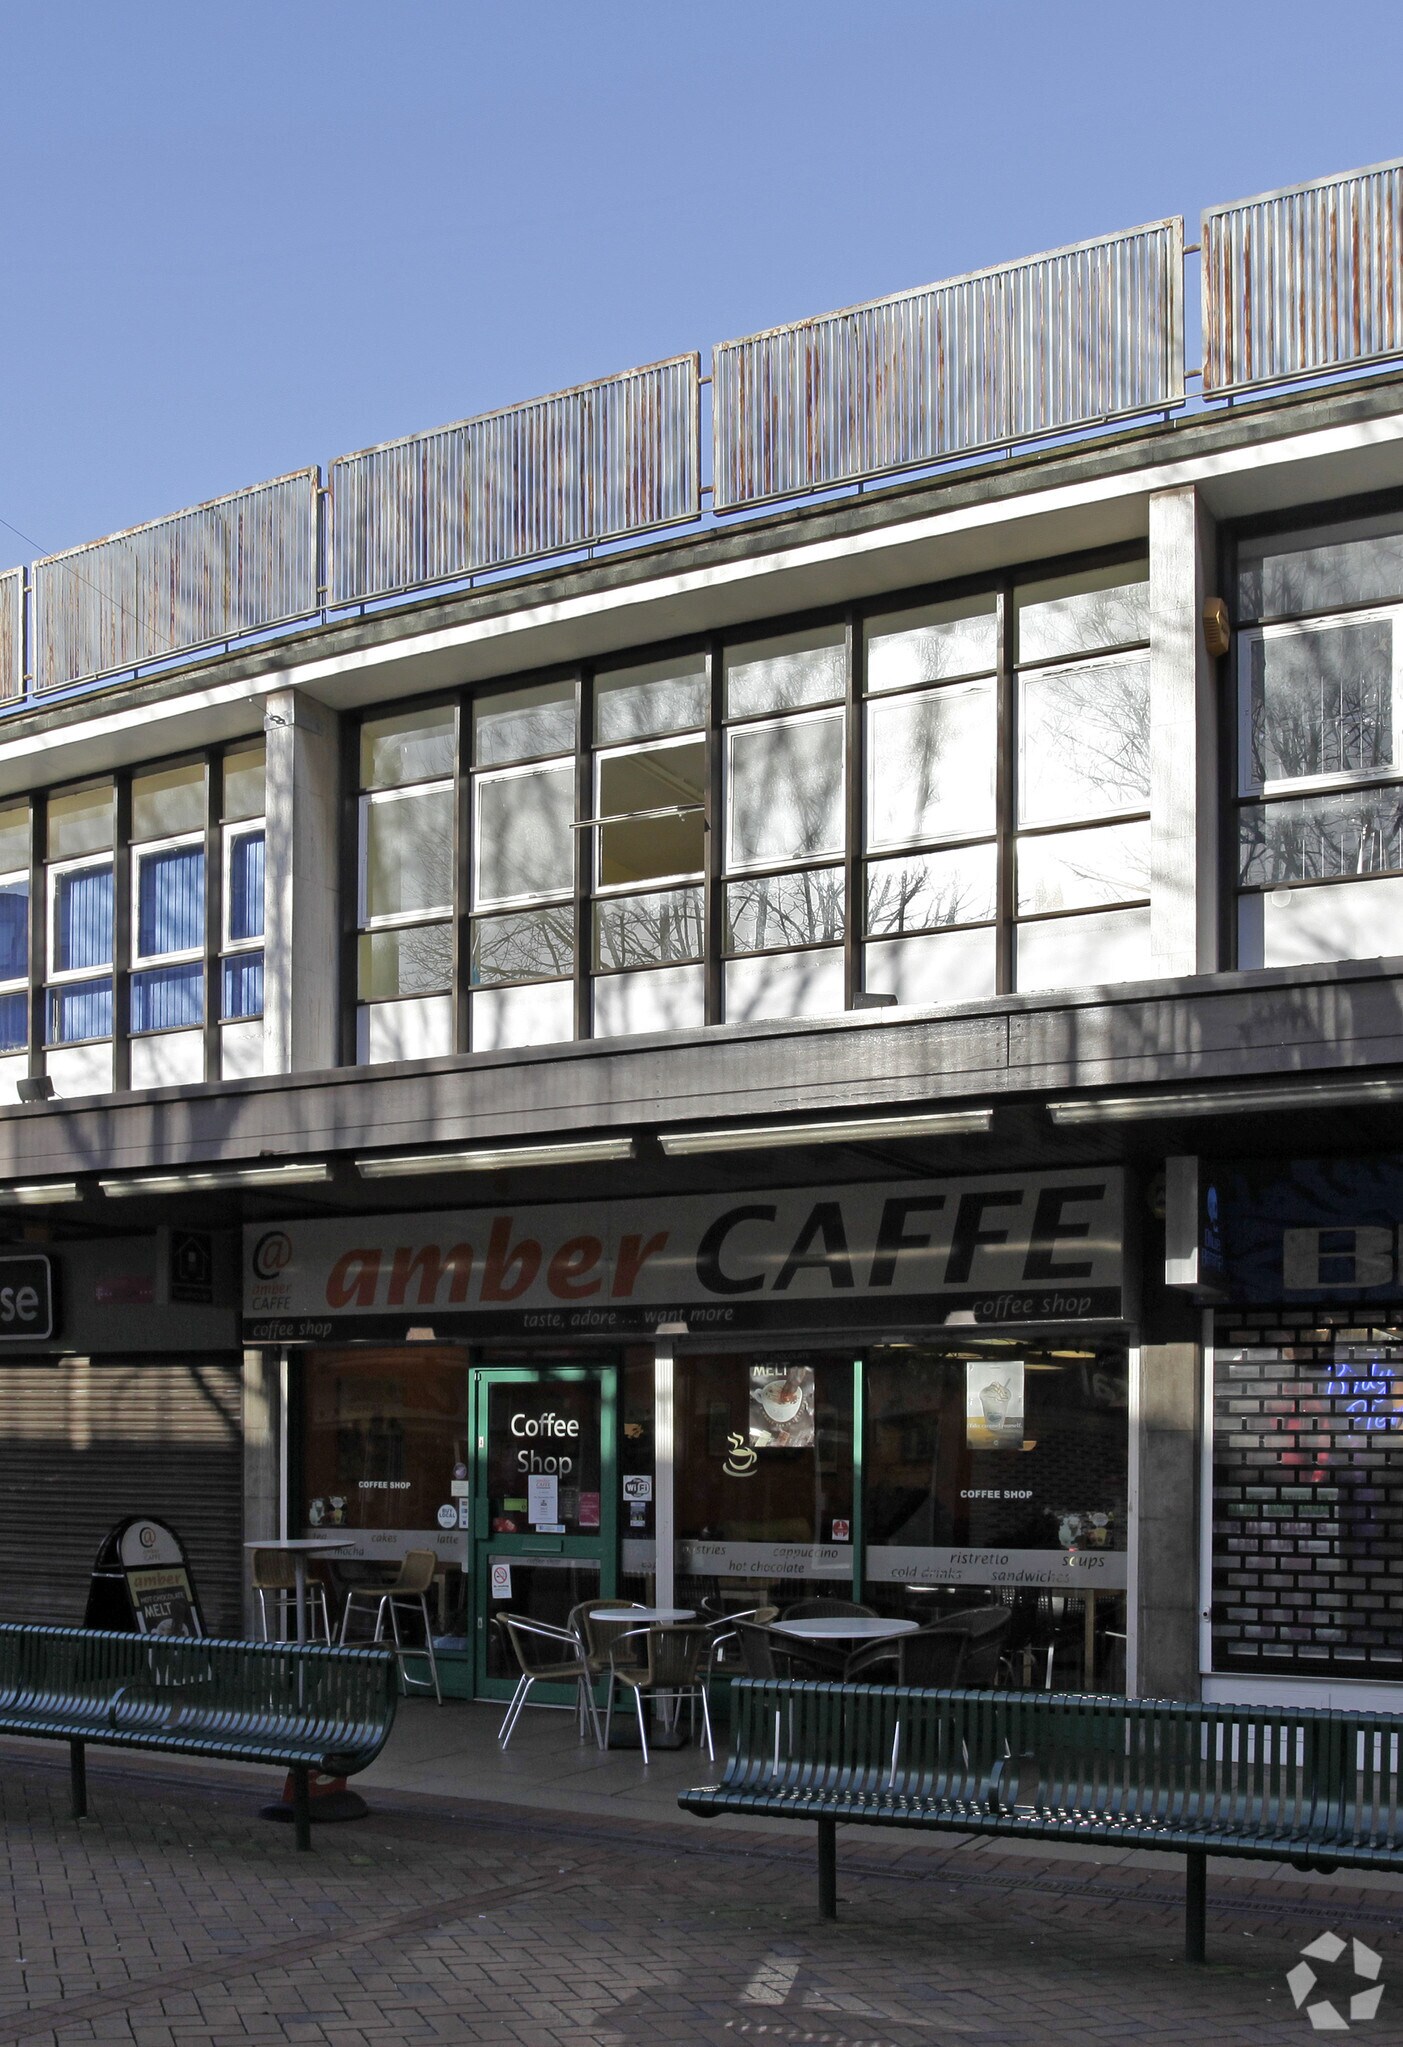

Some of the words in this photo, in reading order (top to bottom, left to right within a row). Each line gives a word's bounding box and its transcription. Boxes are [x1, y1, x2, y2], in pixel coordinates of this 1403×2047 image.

[325, 1215, 669, 1309] amber
[695, 1183, 1107, 1295] CAFFE
[251, 1282, 293, 1296] amber
[252, 1296, 292, 1311] CAFFE
[972, 1293, 1034, 1321] coffee
[1040, 1291, 1092, 1317] shop
[570, 1309, 617, 1326] adore
[644, 1307, 685, 1323] want
[690, 1306, 734, 1322] more
[252, 1319, 294, 1340] coffee
[298, 1319, 333, 1339] shop
[752, 1362, 790, 1377] MELT
[509, 1413, 580, 1438] Coffee
[516, 1448, 573, 1479] Shop
[358, 1480, 388, 1489] COFFEE
[389, 1481, 411, 1490] SHOP
[960, 1489, 1003, 1499] COFFEE
[1004, 1490, 1034, 1500] SHOP
[370, 1532, 398, 1544] cakes
[436, 1533, 459, 1545] latte
[333, 1545, 365, 1557] mocha
[949, 1551, 1010, 1565] ristretto
[728, 1559, 747, 1572] hot
[750, 1560, 805, 1574] chocolate
[890, 1566, 918, 1578] cold
[920, 1566, 963, 1579] drinks
[134, 1571, 182, 1588] amber
[990, 1568, 1071, 1584] sandwiches
[143, 1601, 172, 1618] MELT
